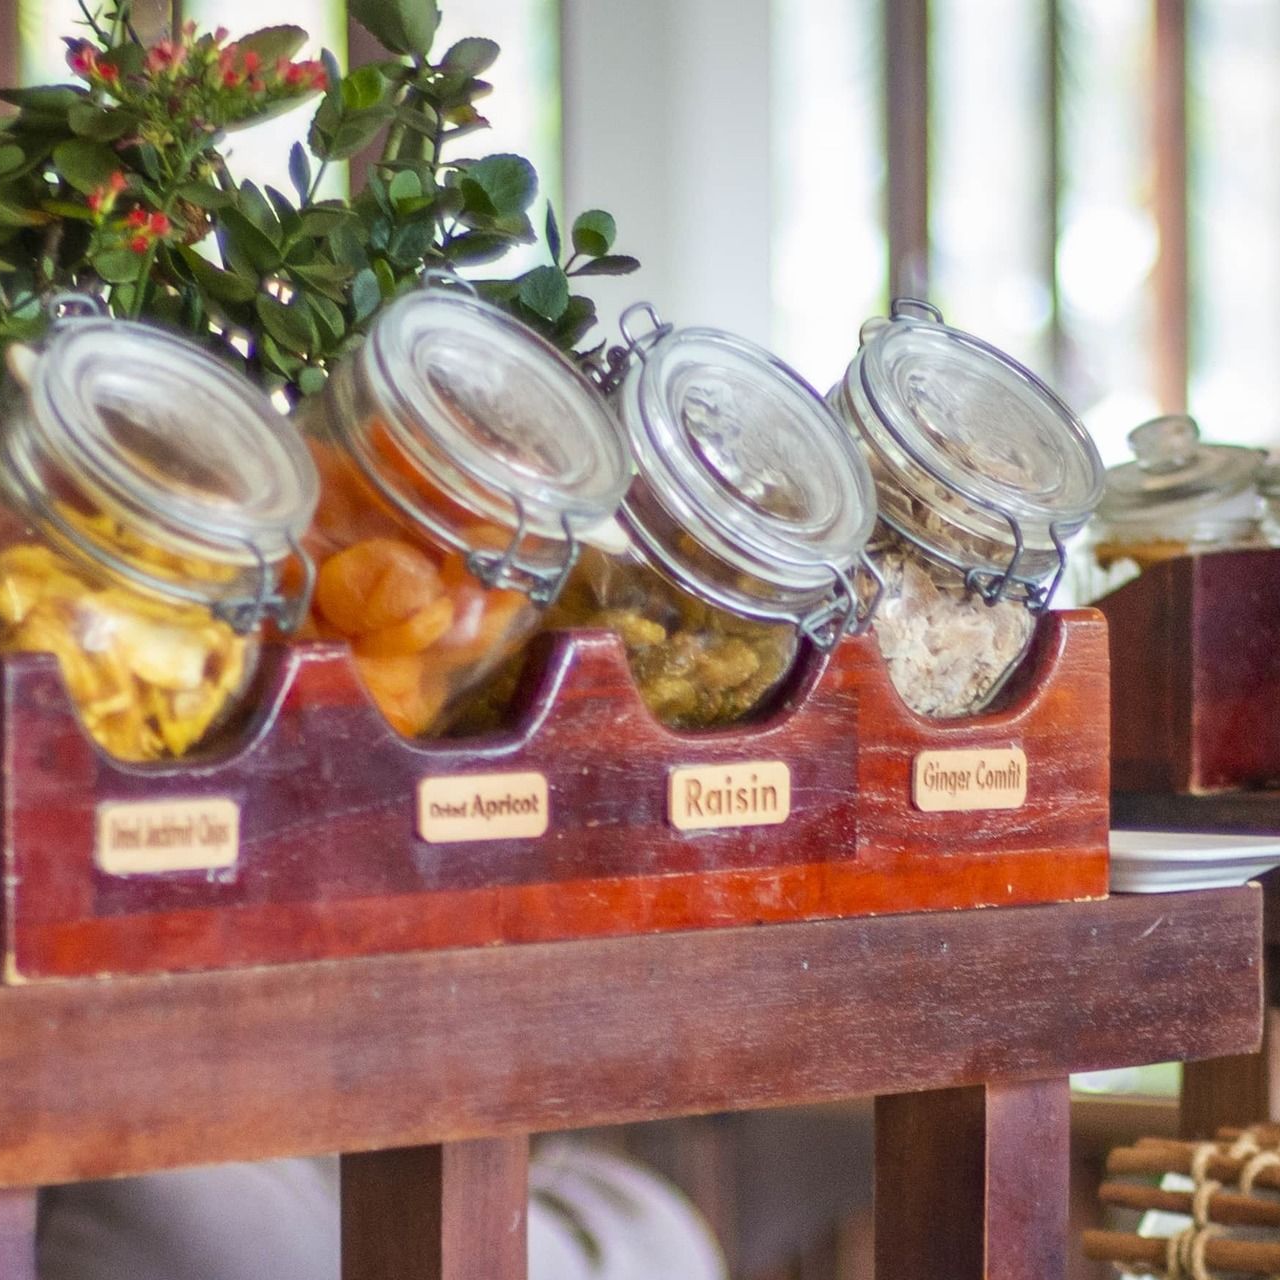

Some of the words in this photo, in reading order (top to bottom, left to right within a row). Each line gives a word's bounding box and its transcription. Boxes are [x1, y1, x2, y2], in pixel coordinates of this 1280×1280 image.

[685, 773, 778, 818] Raisin
[923, 761, 971, 797] Ginger
[975, 758, 1021, 791] Comfit
[470, 793, 540, 820] Apricot
